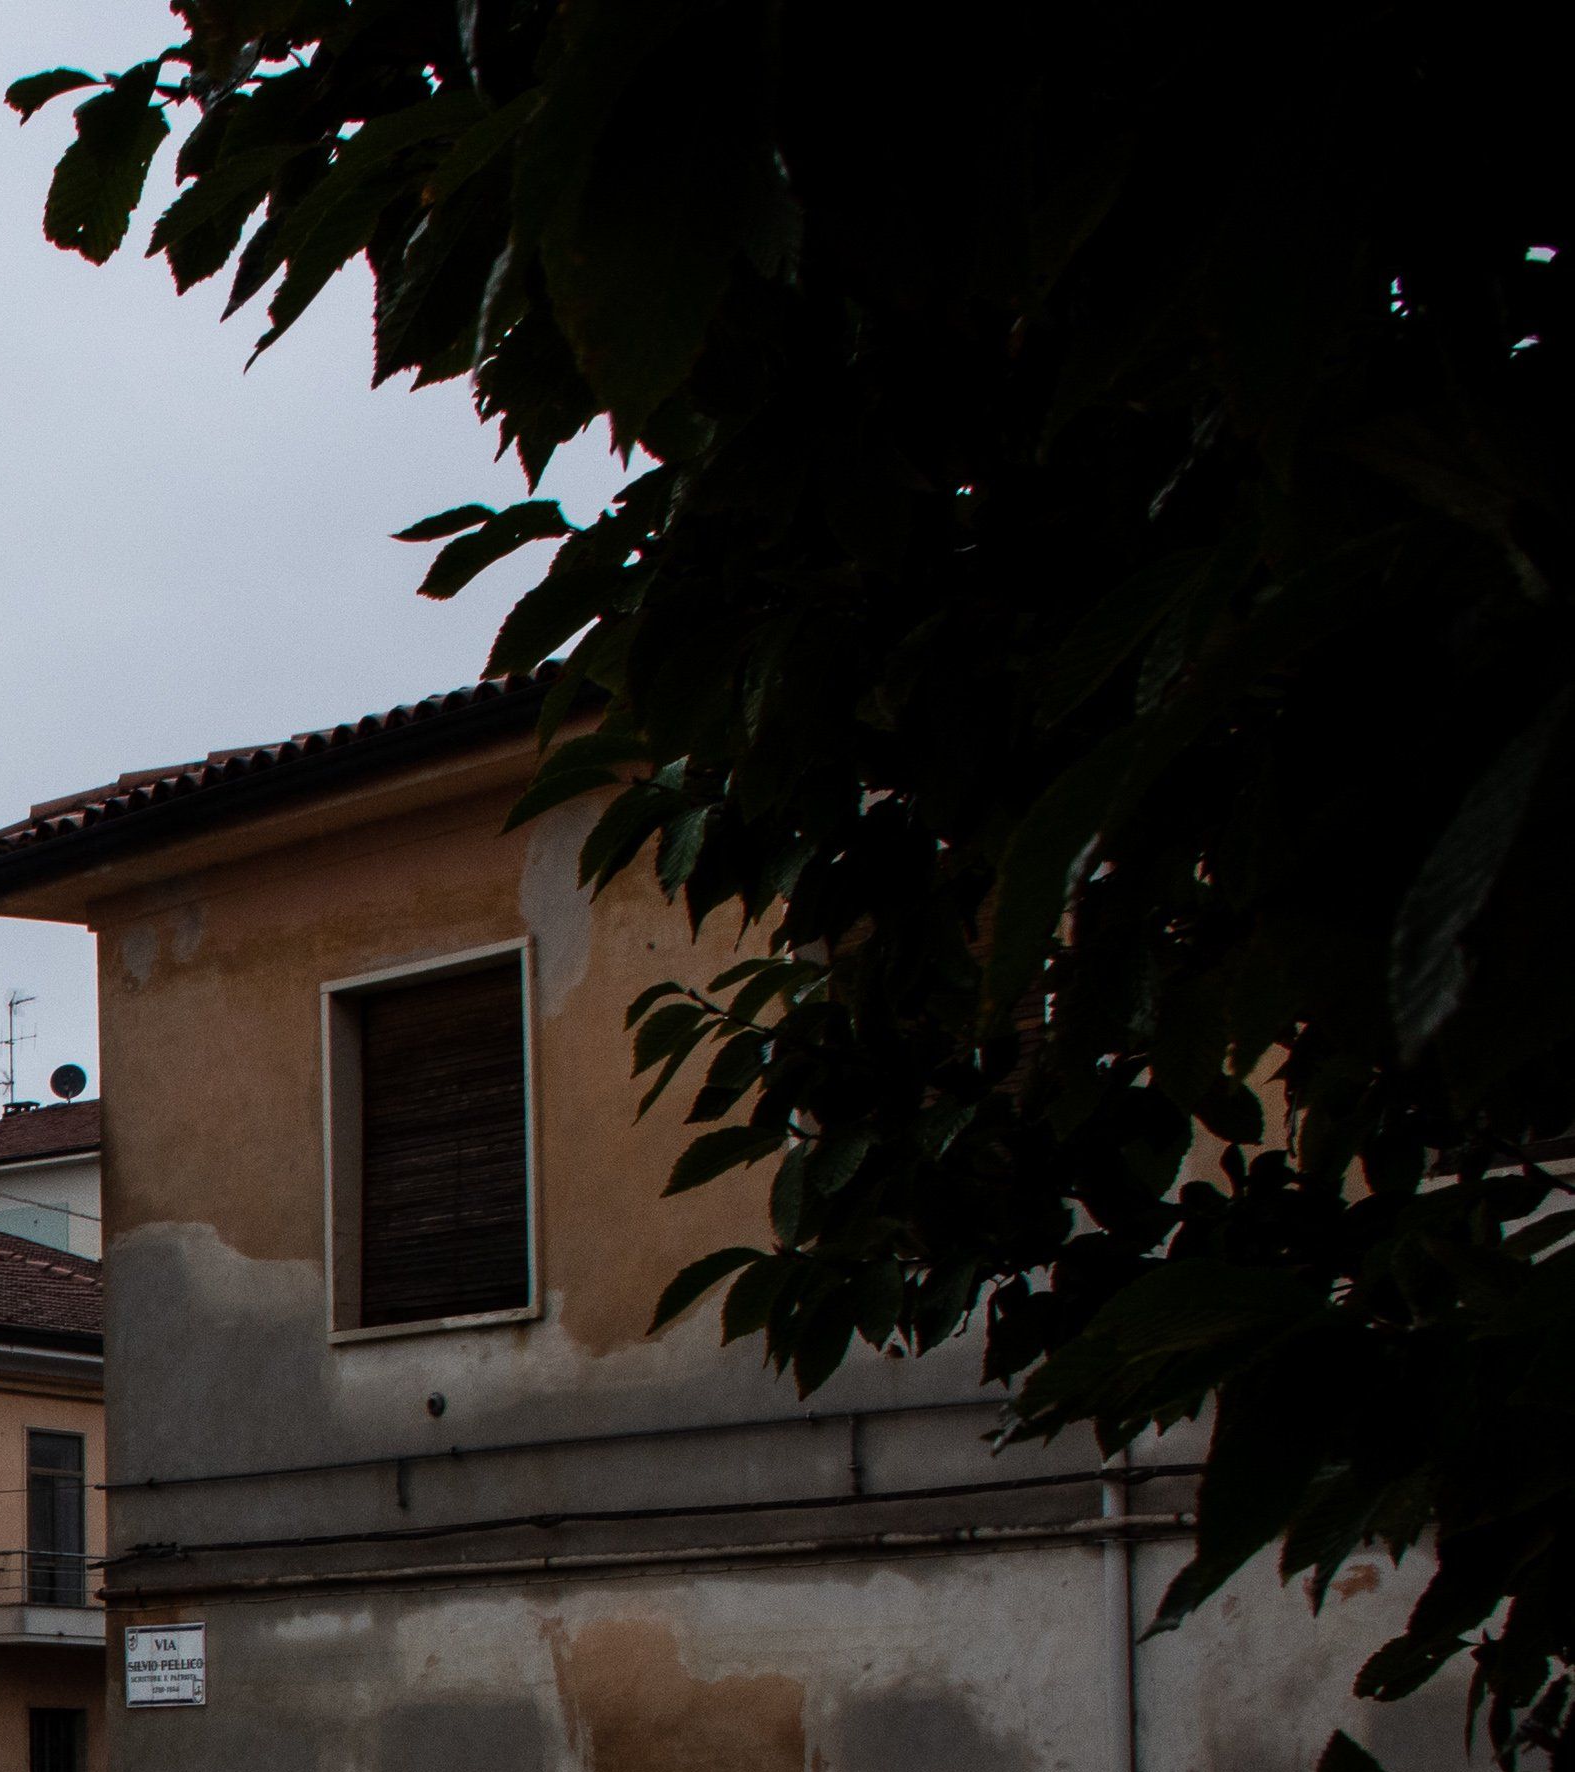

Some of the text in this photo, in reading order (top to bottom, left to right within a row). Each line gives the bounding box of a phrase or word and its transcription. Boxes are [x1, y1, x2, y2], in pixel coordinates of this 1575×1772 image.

[155, 1639, 177, 1651] VIA
[128, 1658, 204, 1673] SILVIO PELLICO
